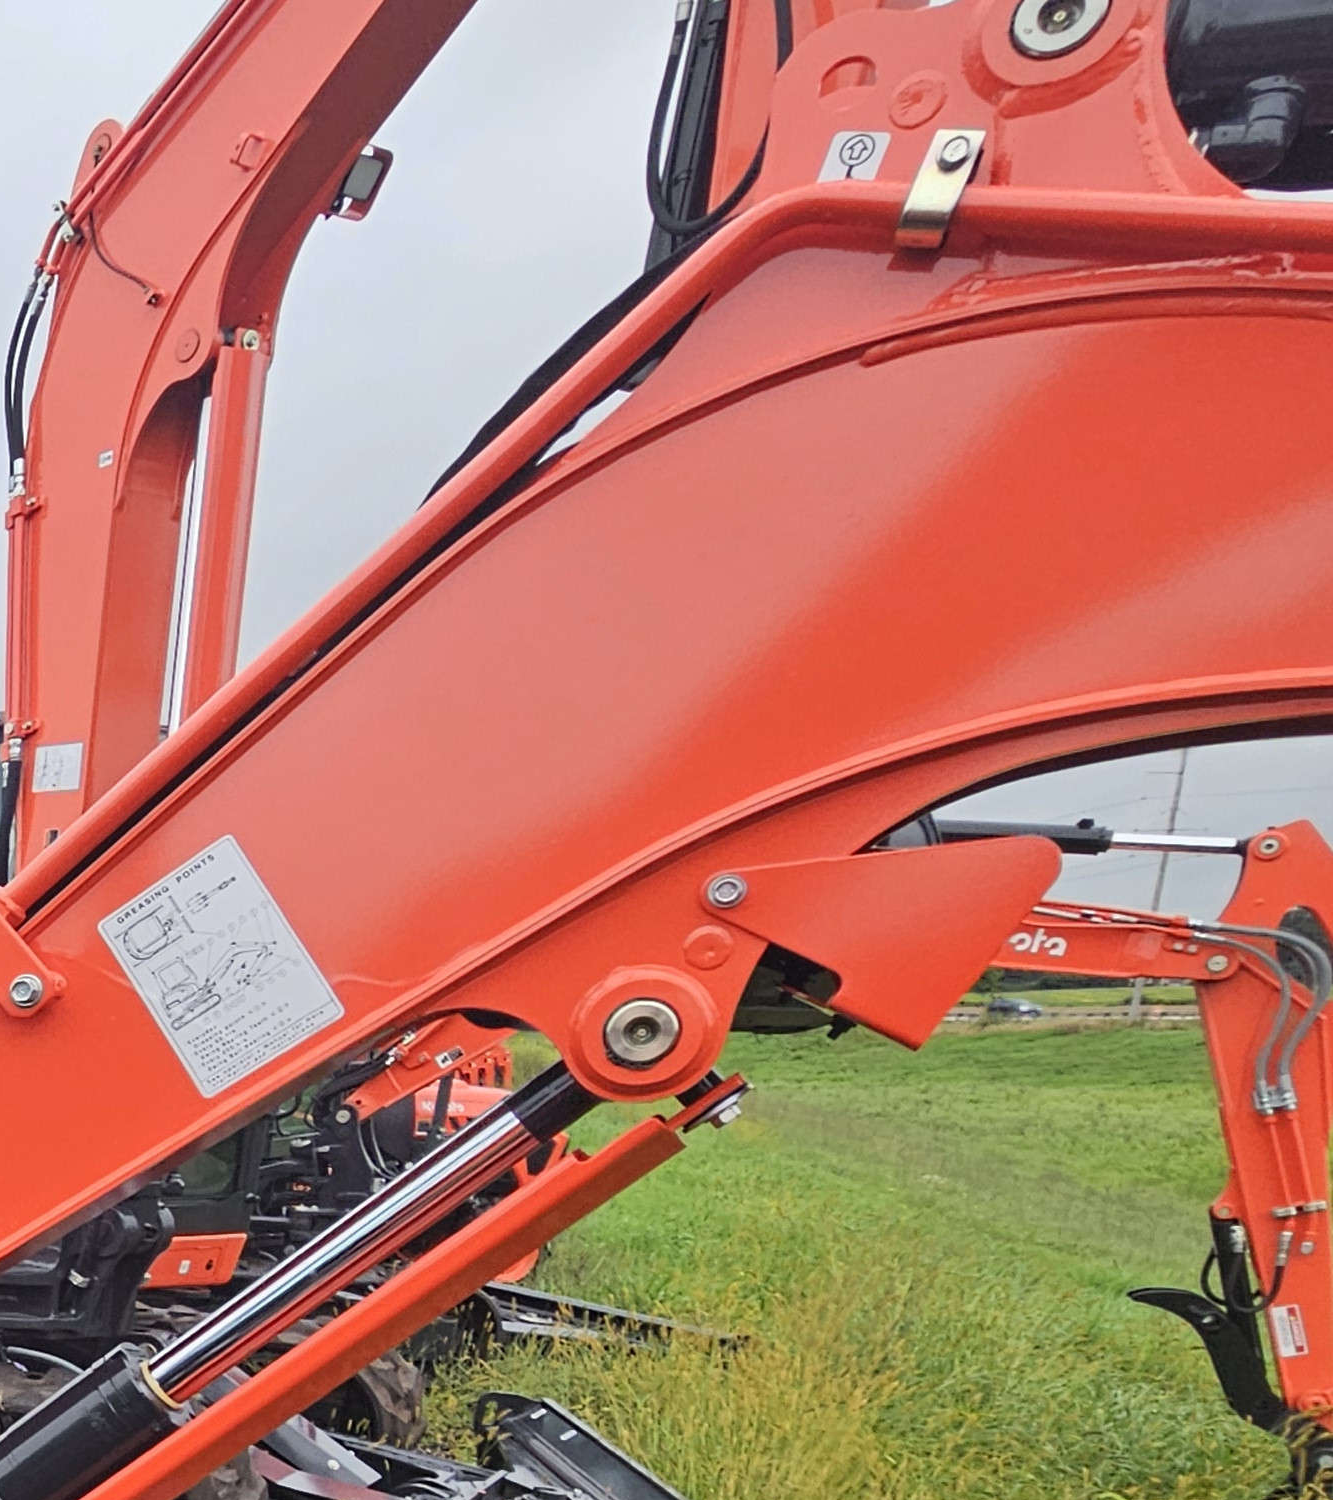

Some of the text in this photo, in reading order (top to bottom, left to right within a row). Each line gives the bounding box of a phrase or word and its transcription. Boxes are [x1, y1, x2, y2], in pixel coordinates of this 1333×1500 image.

[117, 854, 215, 924] GREASING POINTS
[1009, 928, 1067, 957] ota
